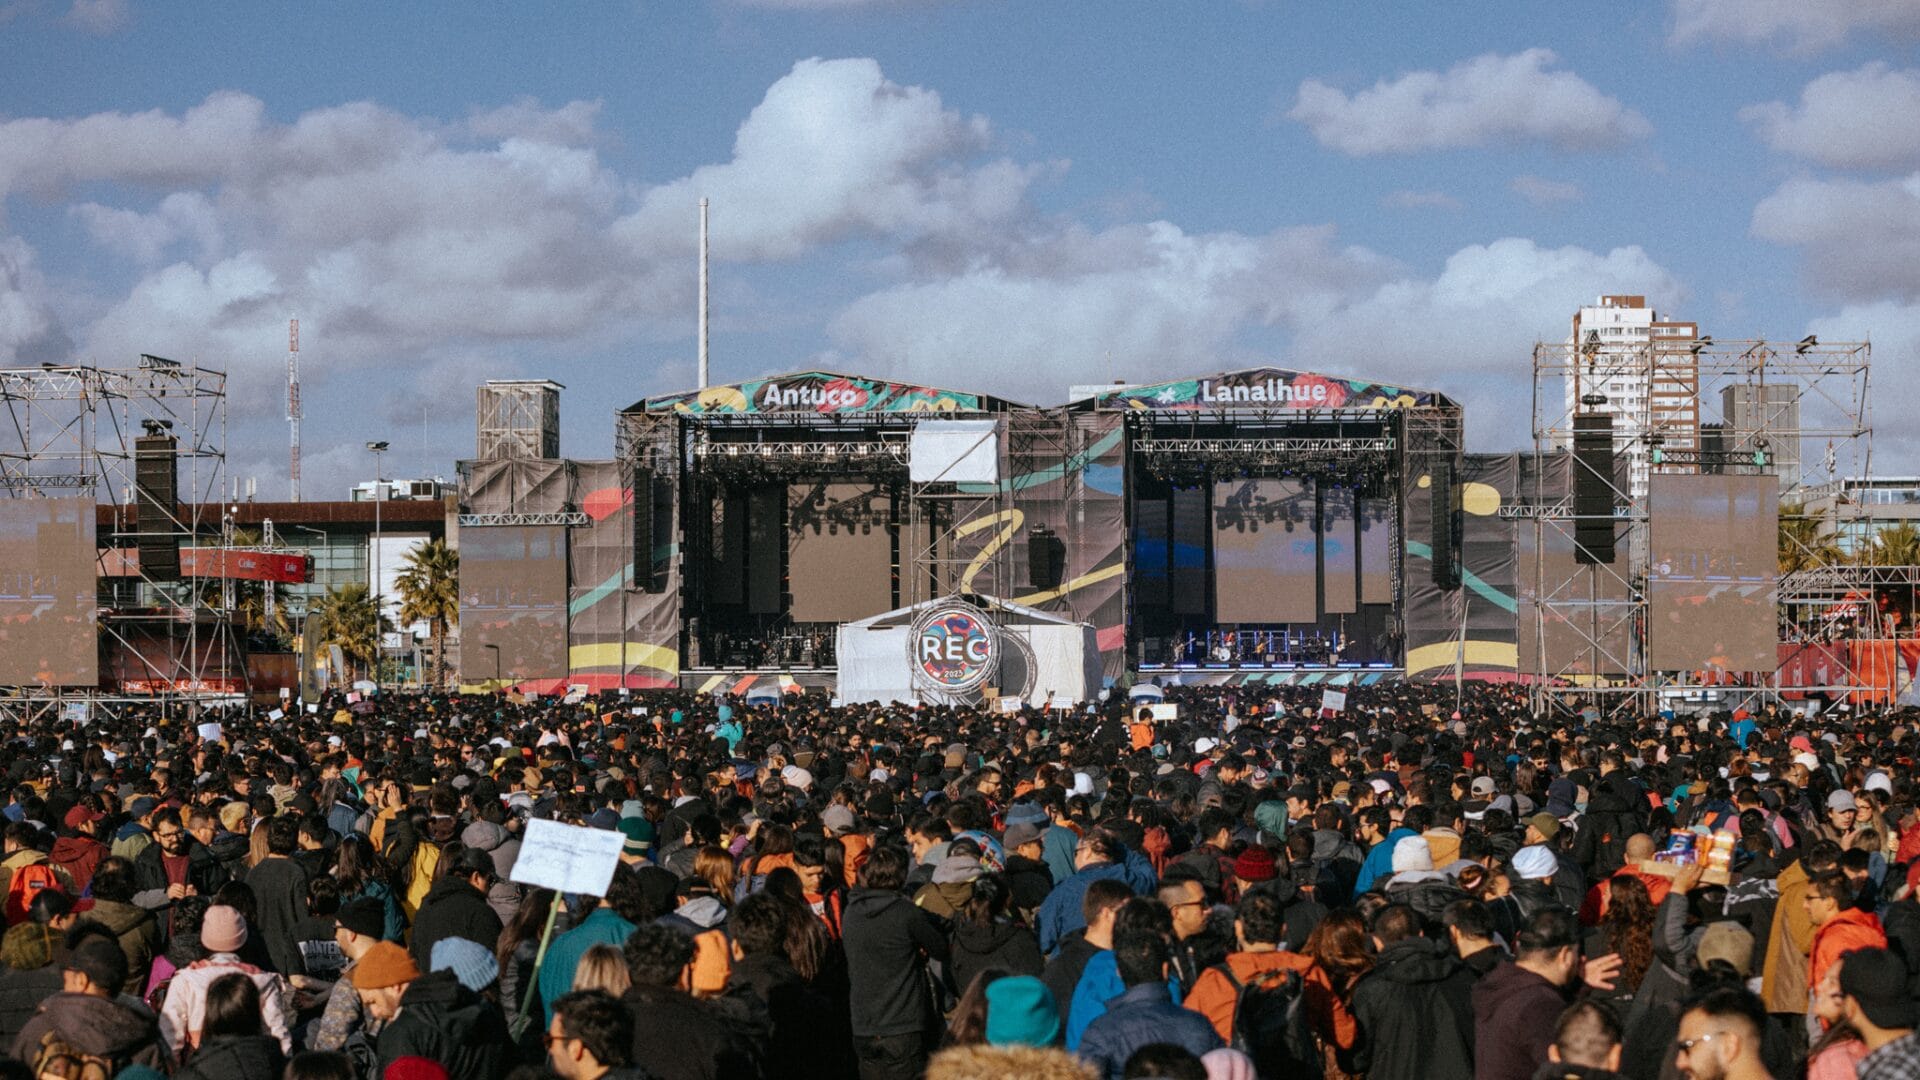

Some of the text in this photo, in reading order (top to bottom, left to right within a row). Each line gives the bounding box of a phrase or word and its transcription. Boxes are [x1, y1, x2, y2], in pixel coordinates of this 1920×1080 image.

[763, 383, 857, 405] Antuco
[1203, 379, 1327, 401] Lanalhue
[922, 635, 989, 662] REC
